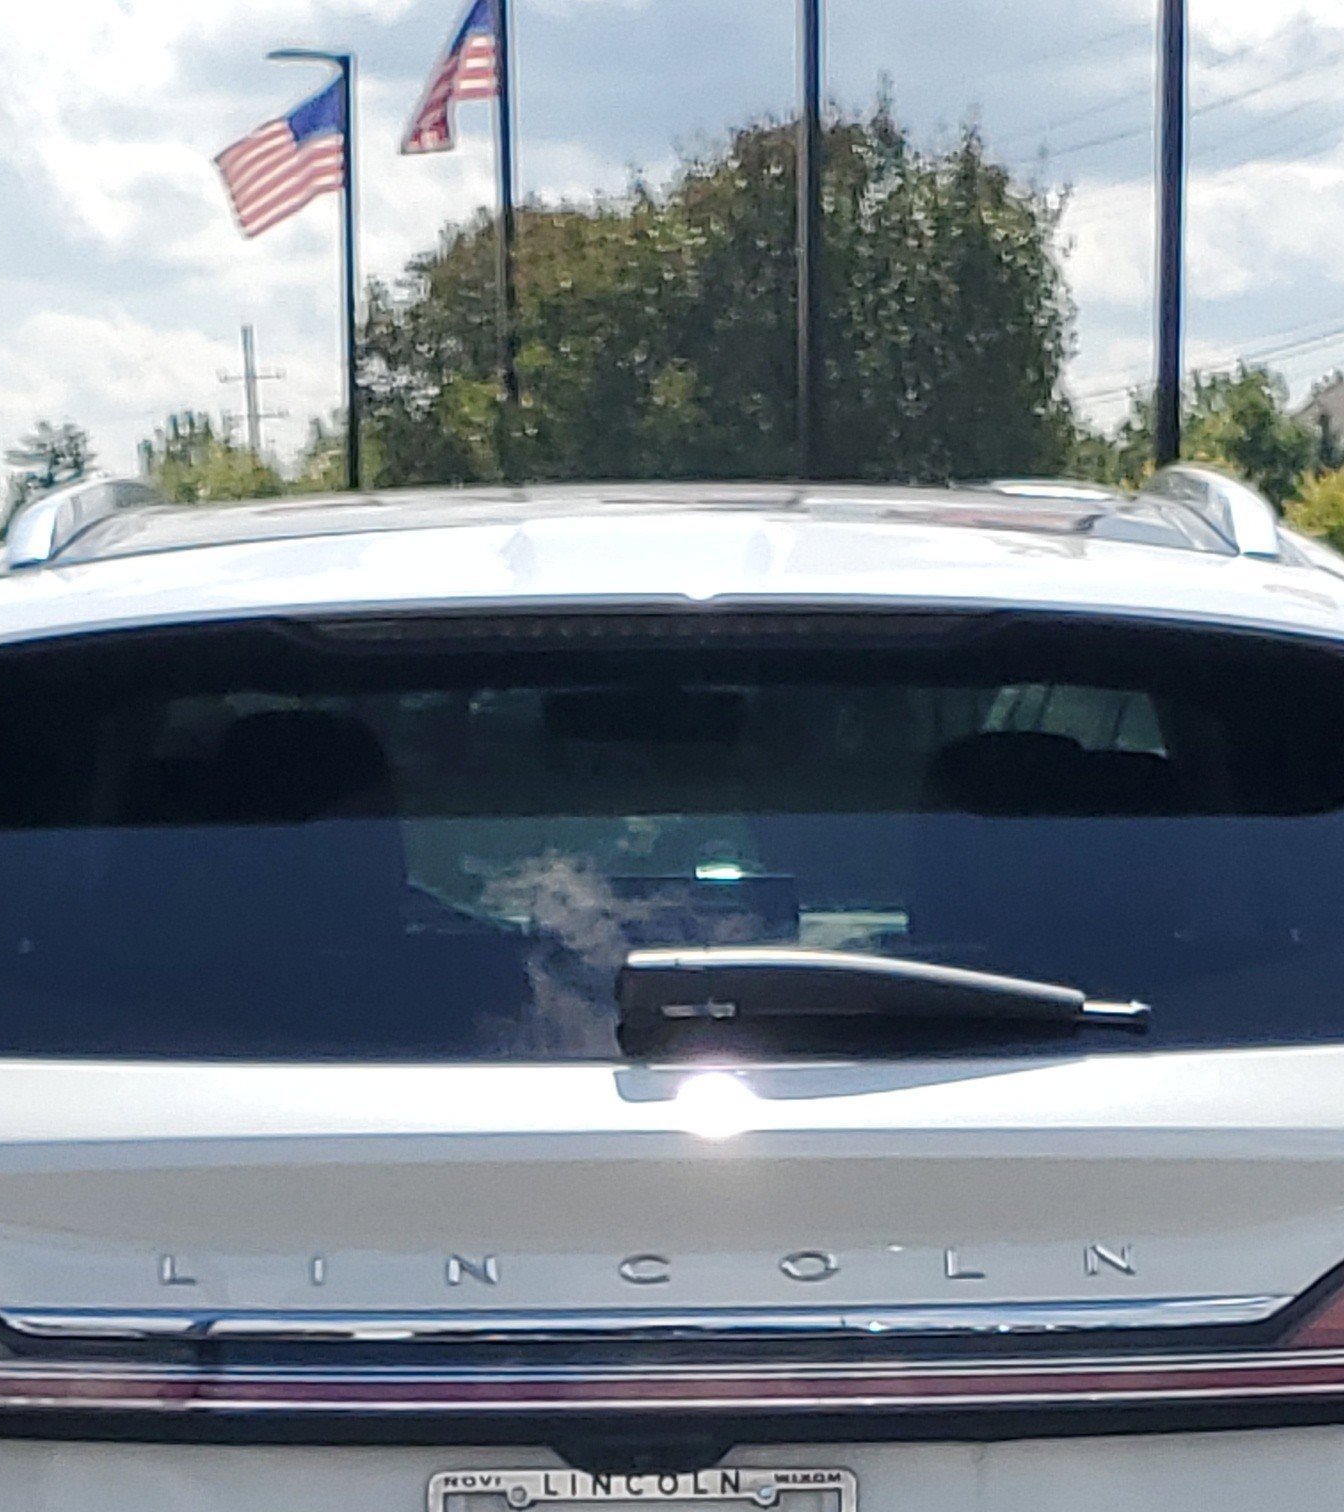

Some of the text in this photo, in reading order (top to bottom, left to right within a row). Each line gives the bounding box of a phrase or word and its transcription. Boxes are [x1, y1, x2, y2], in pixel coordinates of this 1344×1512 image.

[159, 1244, 1136, 1286] LINCOLN
[444, 1475, 502, 1488] NOVI
[544, 1471, 741, 1495] LINCOLN
